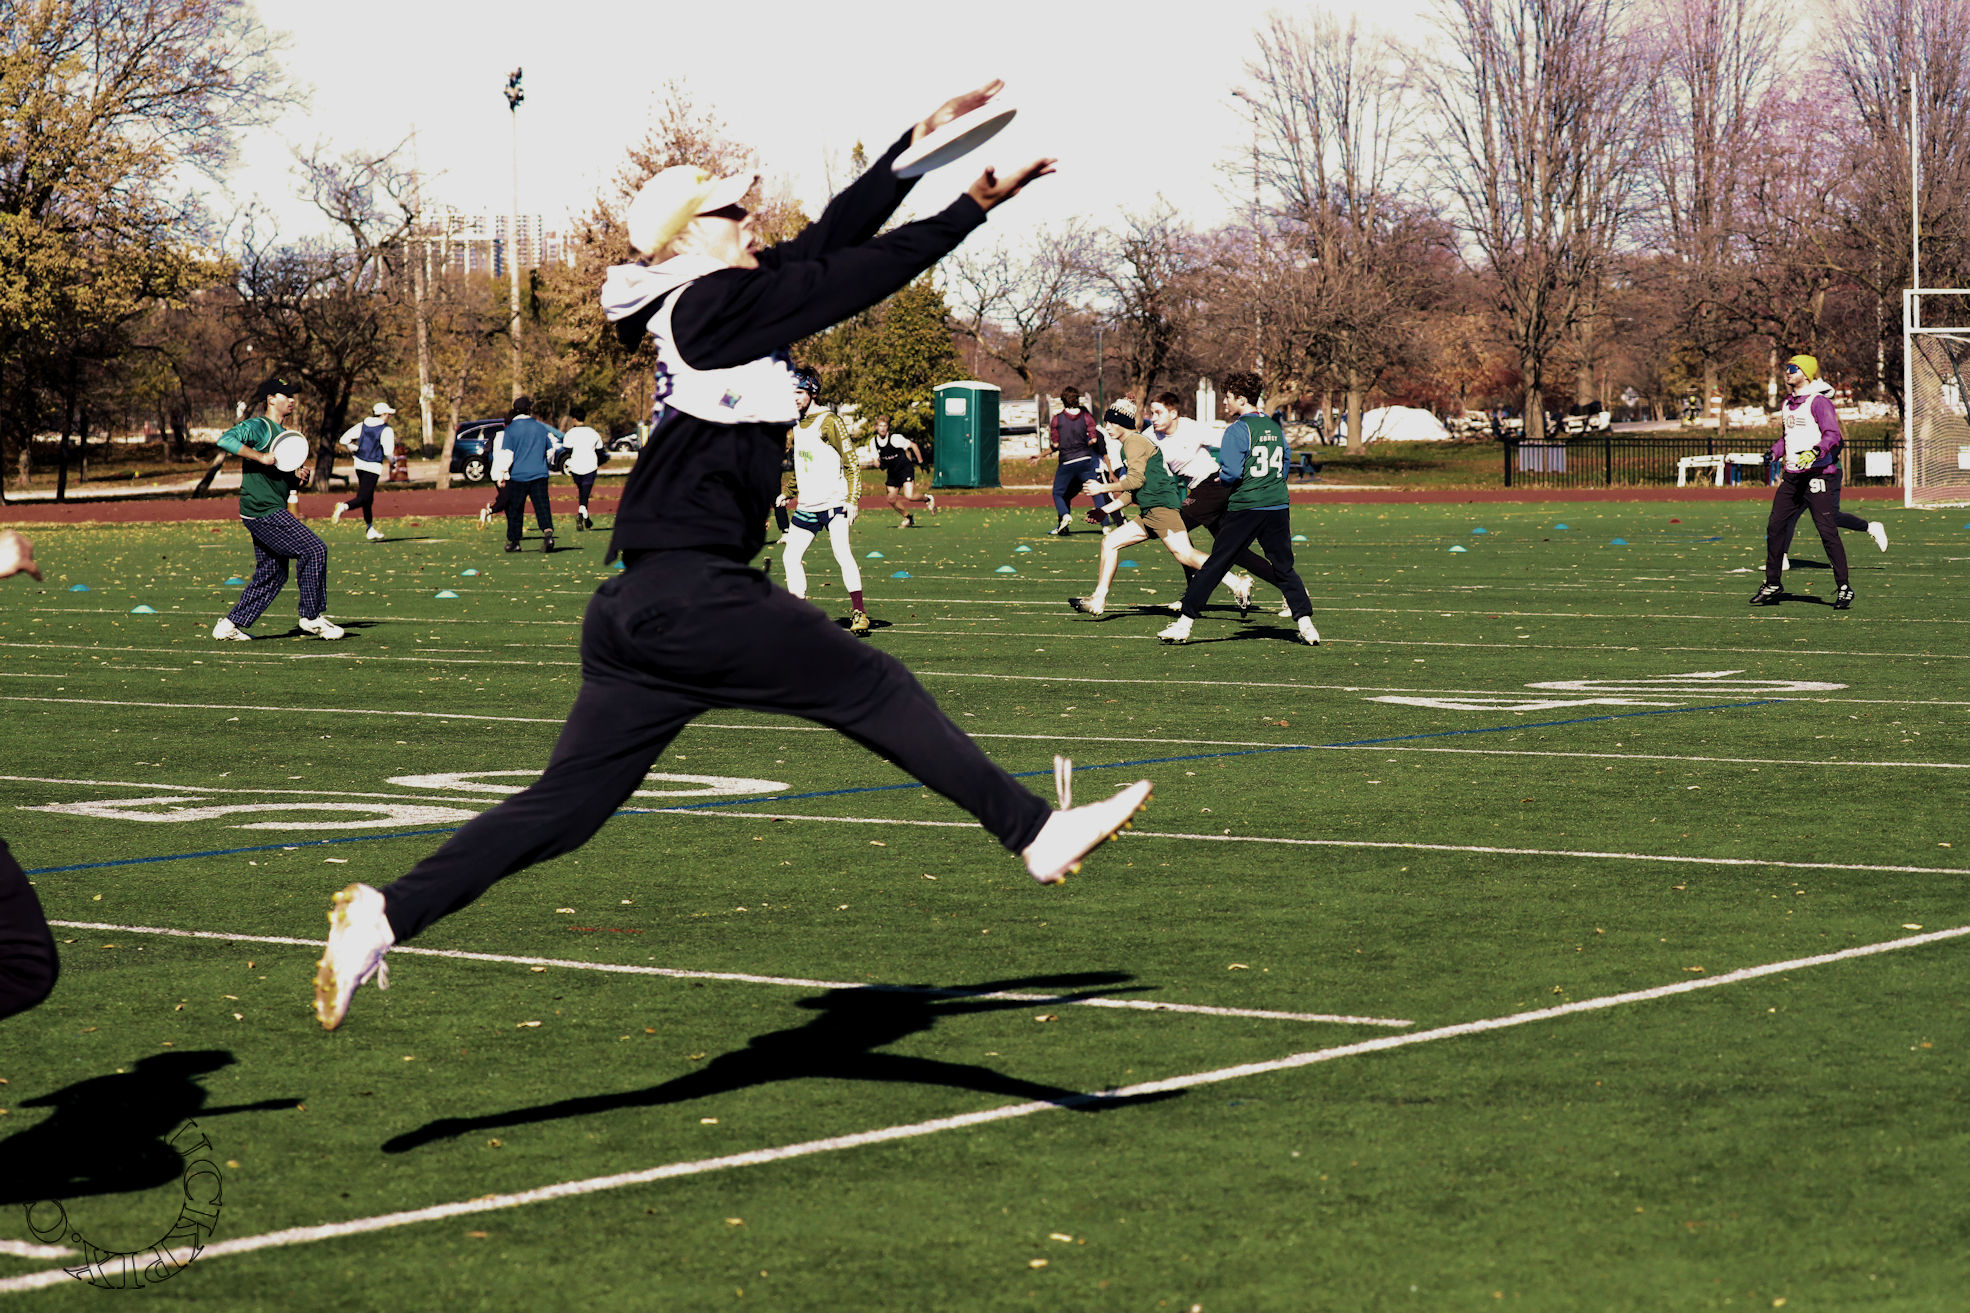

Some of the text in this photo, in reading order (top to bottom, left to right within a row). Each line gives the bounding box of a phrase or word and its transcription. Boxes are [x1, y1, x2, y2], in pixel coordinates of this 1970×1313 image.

[1250, 445, 1284, 479] 34
[1809, 478, 1827, 494] 91
[14, 769, 791, 830] 50
